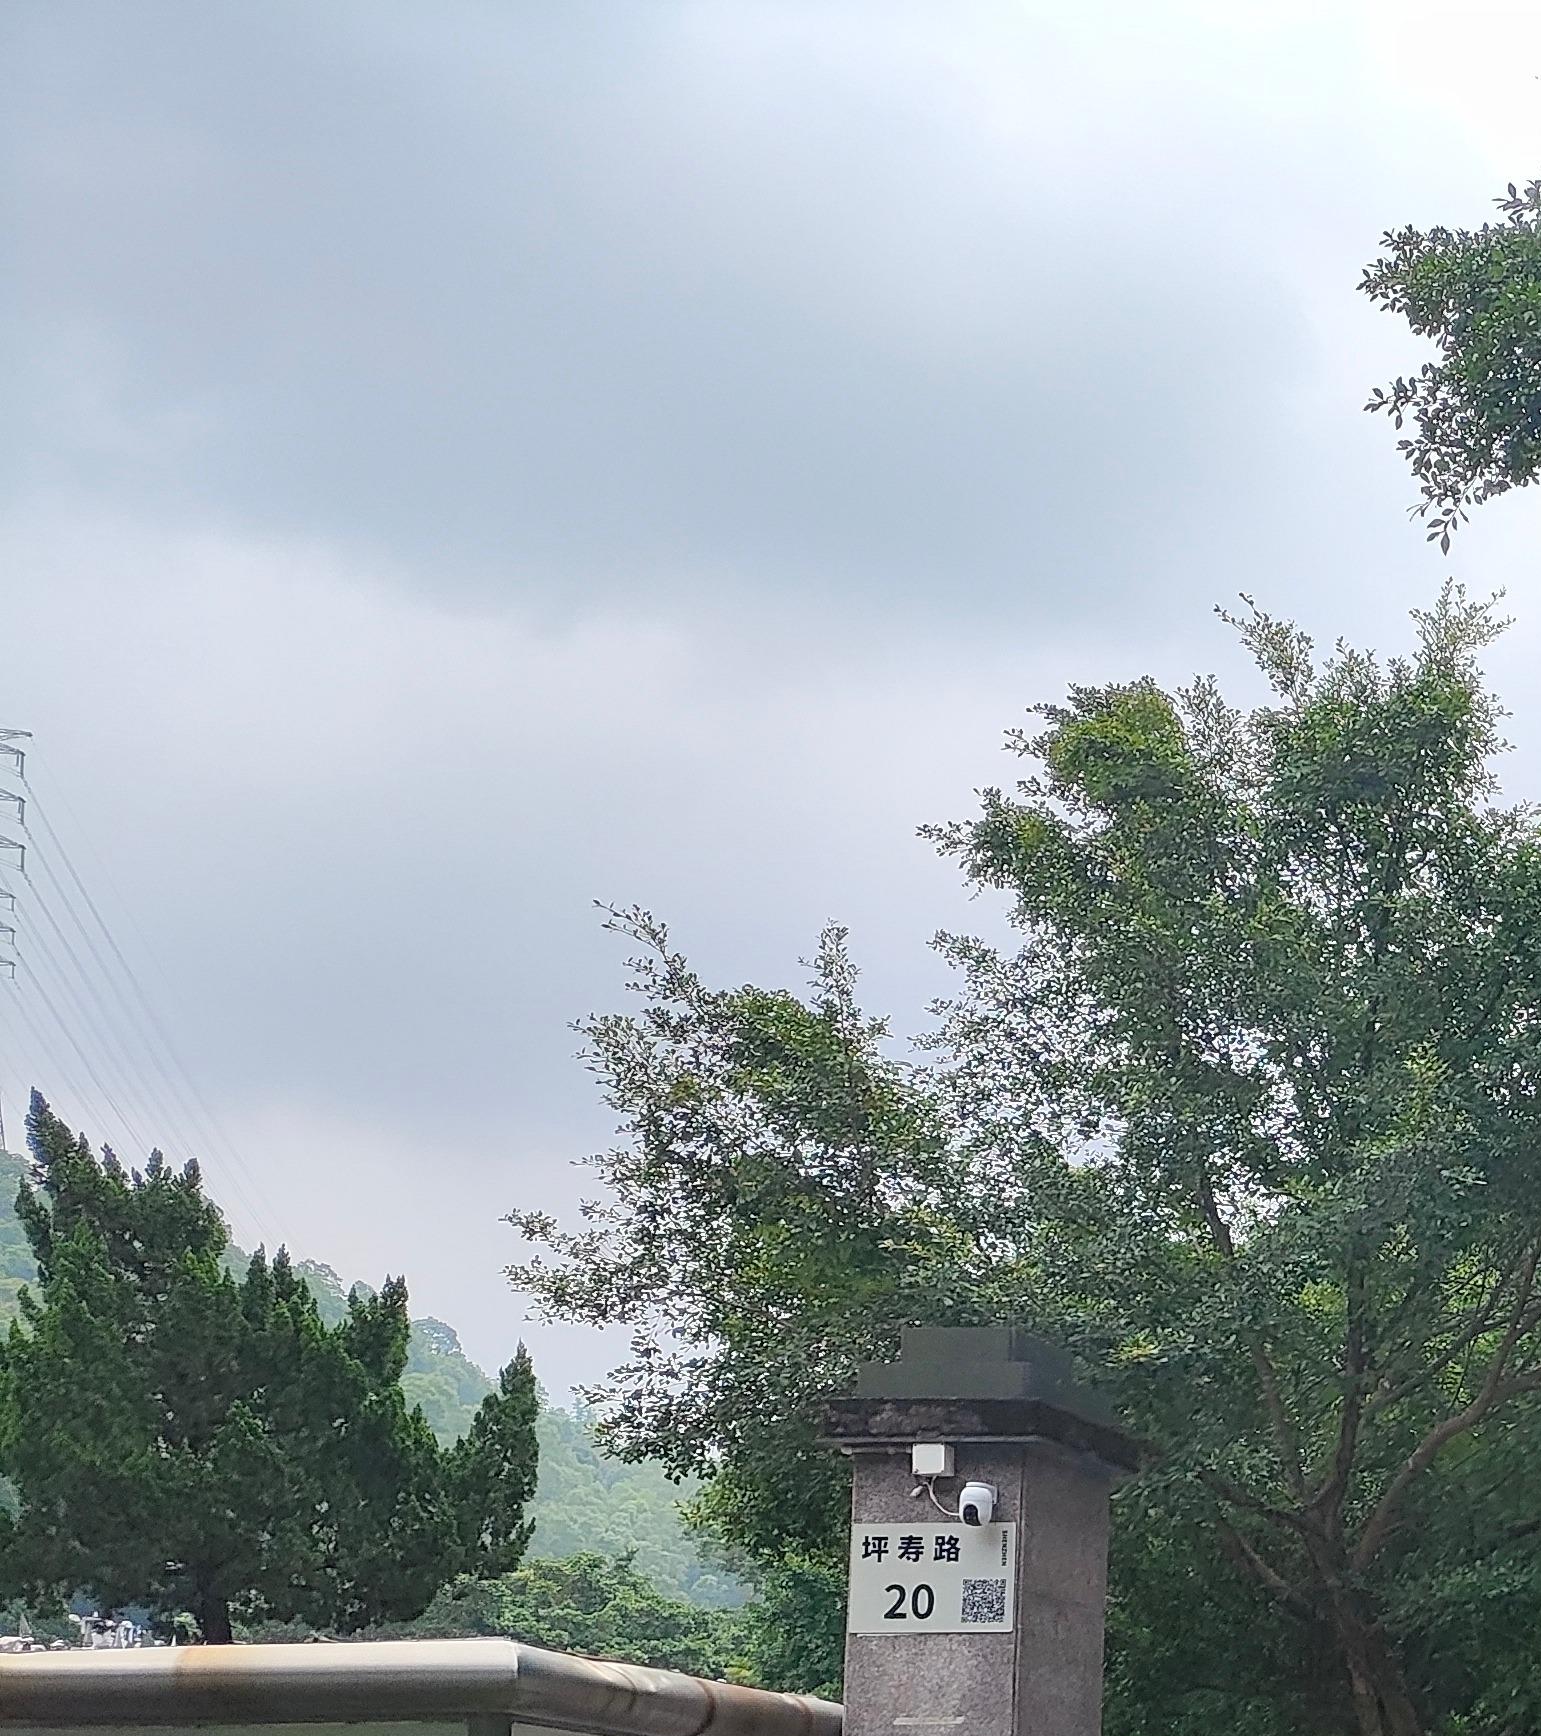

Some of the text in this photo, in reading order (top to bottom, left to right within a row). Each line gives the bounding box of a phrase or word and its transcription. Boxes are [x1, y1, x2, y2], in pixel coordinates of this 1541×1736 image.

[861, 1535, 961, 1563] 坪寿路
[883, 1584, 935, 1620] 20
